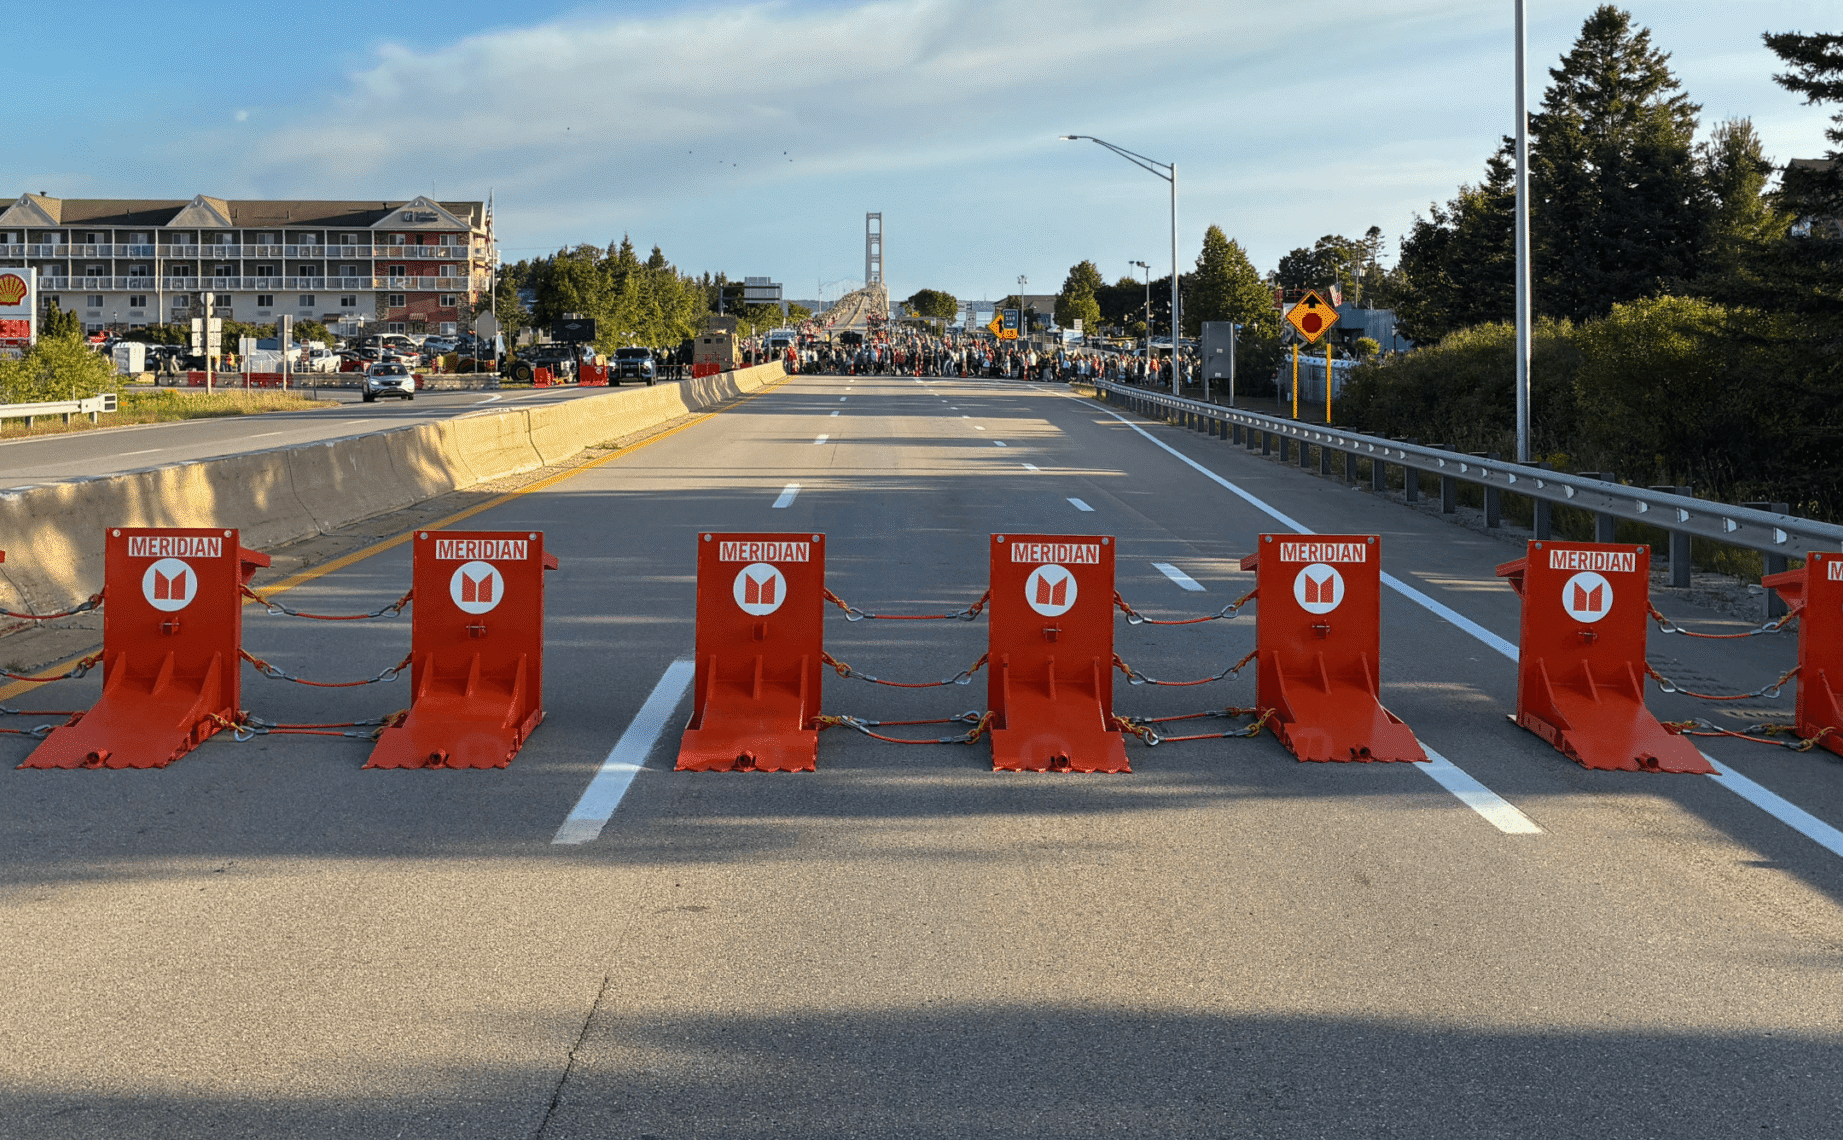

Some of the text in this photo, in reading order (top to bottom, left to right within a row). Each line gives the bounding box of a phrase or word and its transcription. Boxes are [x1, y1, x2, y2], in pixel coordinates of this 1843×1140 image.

[131, 537, 219, 556] MERIDIAN
[439, 541, 525, 559] MERIDIAN
[722, 543, 807, 561] MERIDIAN
[1014, 544, 1097, 563] MERIDIAN
[1283, 543, 1363, 561] MERIDIAN
[1552, 550, 1633, 571] MERIDIAN
